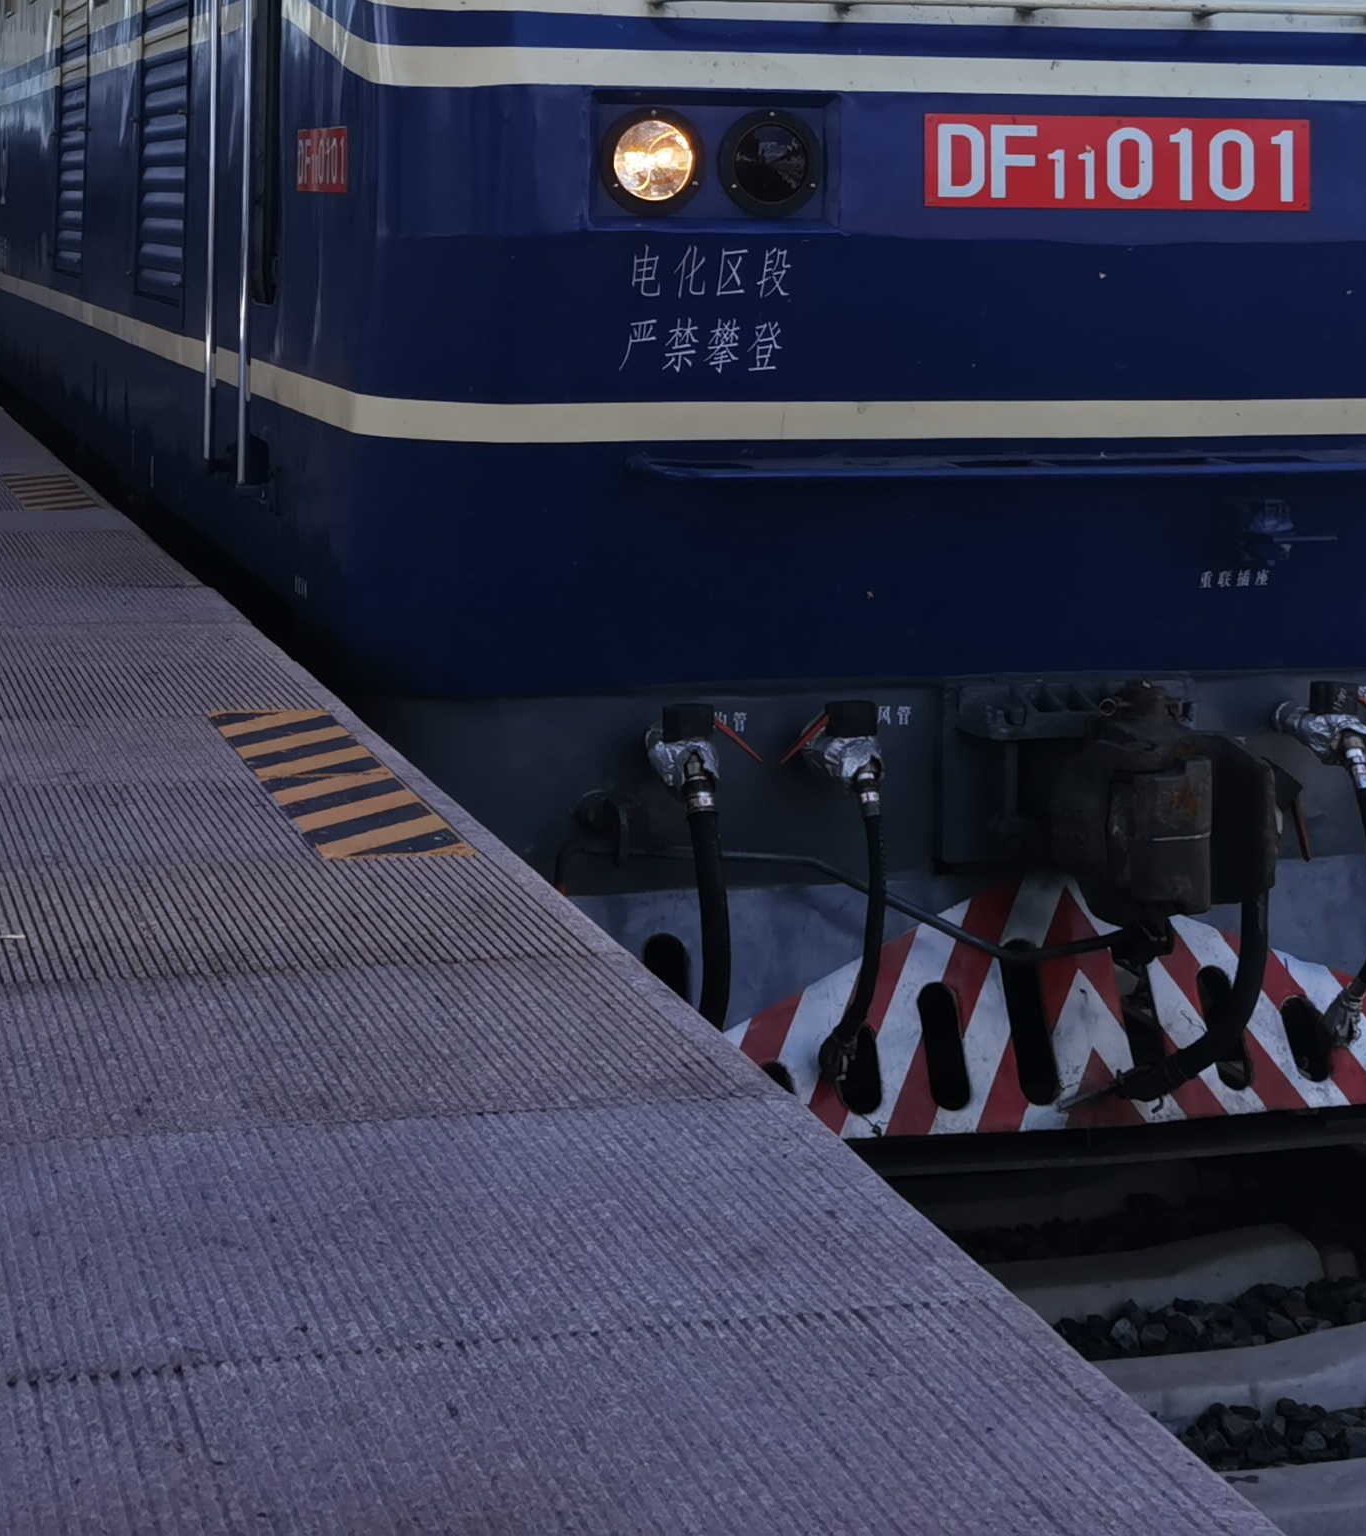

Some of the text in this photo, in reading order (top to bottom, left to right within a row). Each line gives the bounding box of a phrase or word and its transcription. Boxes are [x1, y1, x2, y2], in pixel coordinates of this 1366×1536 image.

[631, 244, 792, 298] 电化区段
[618, 317, 783, 373] 严禁攀登
[1198, 569, 1271, 588] 重联插座
